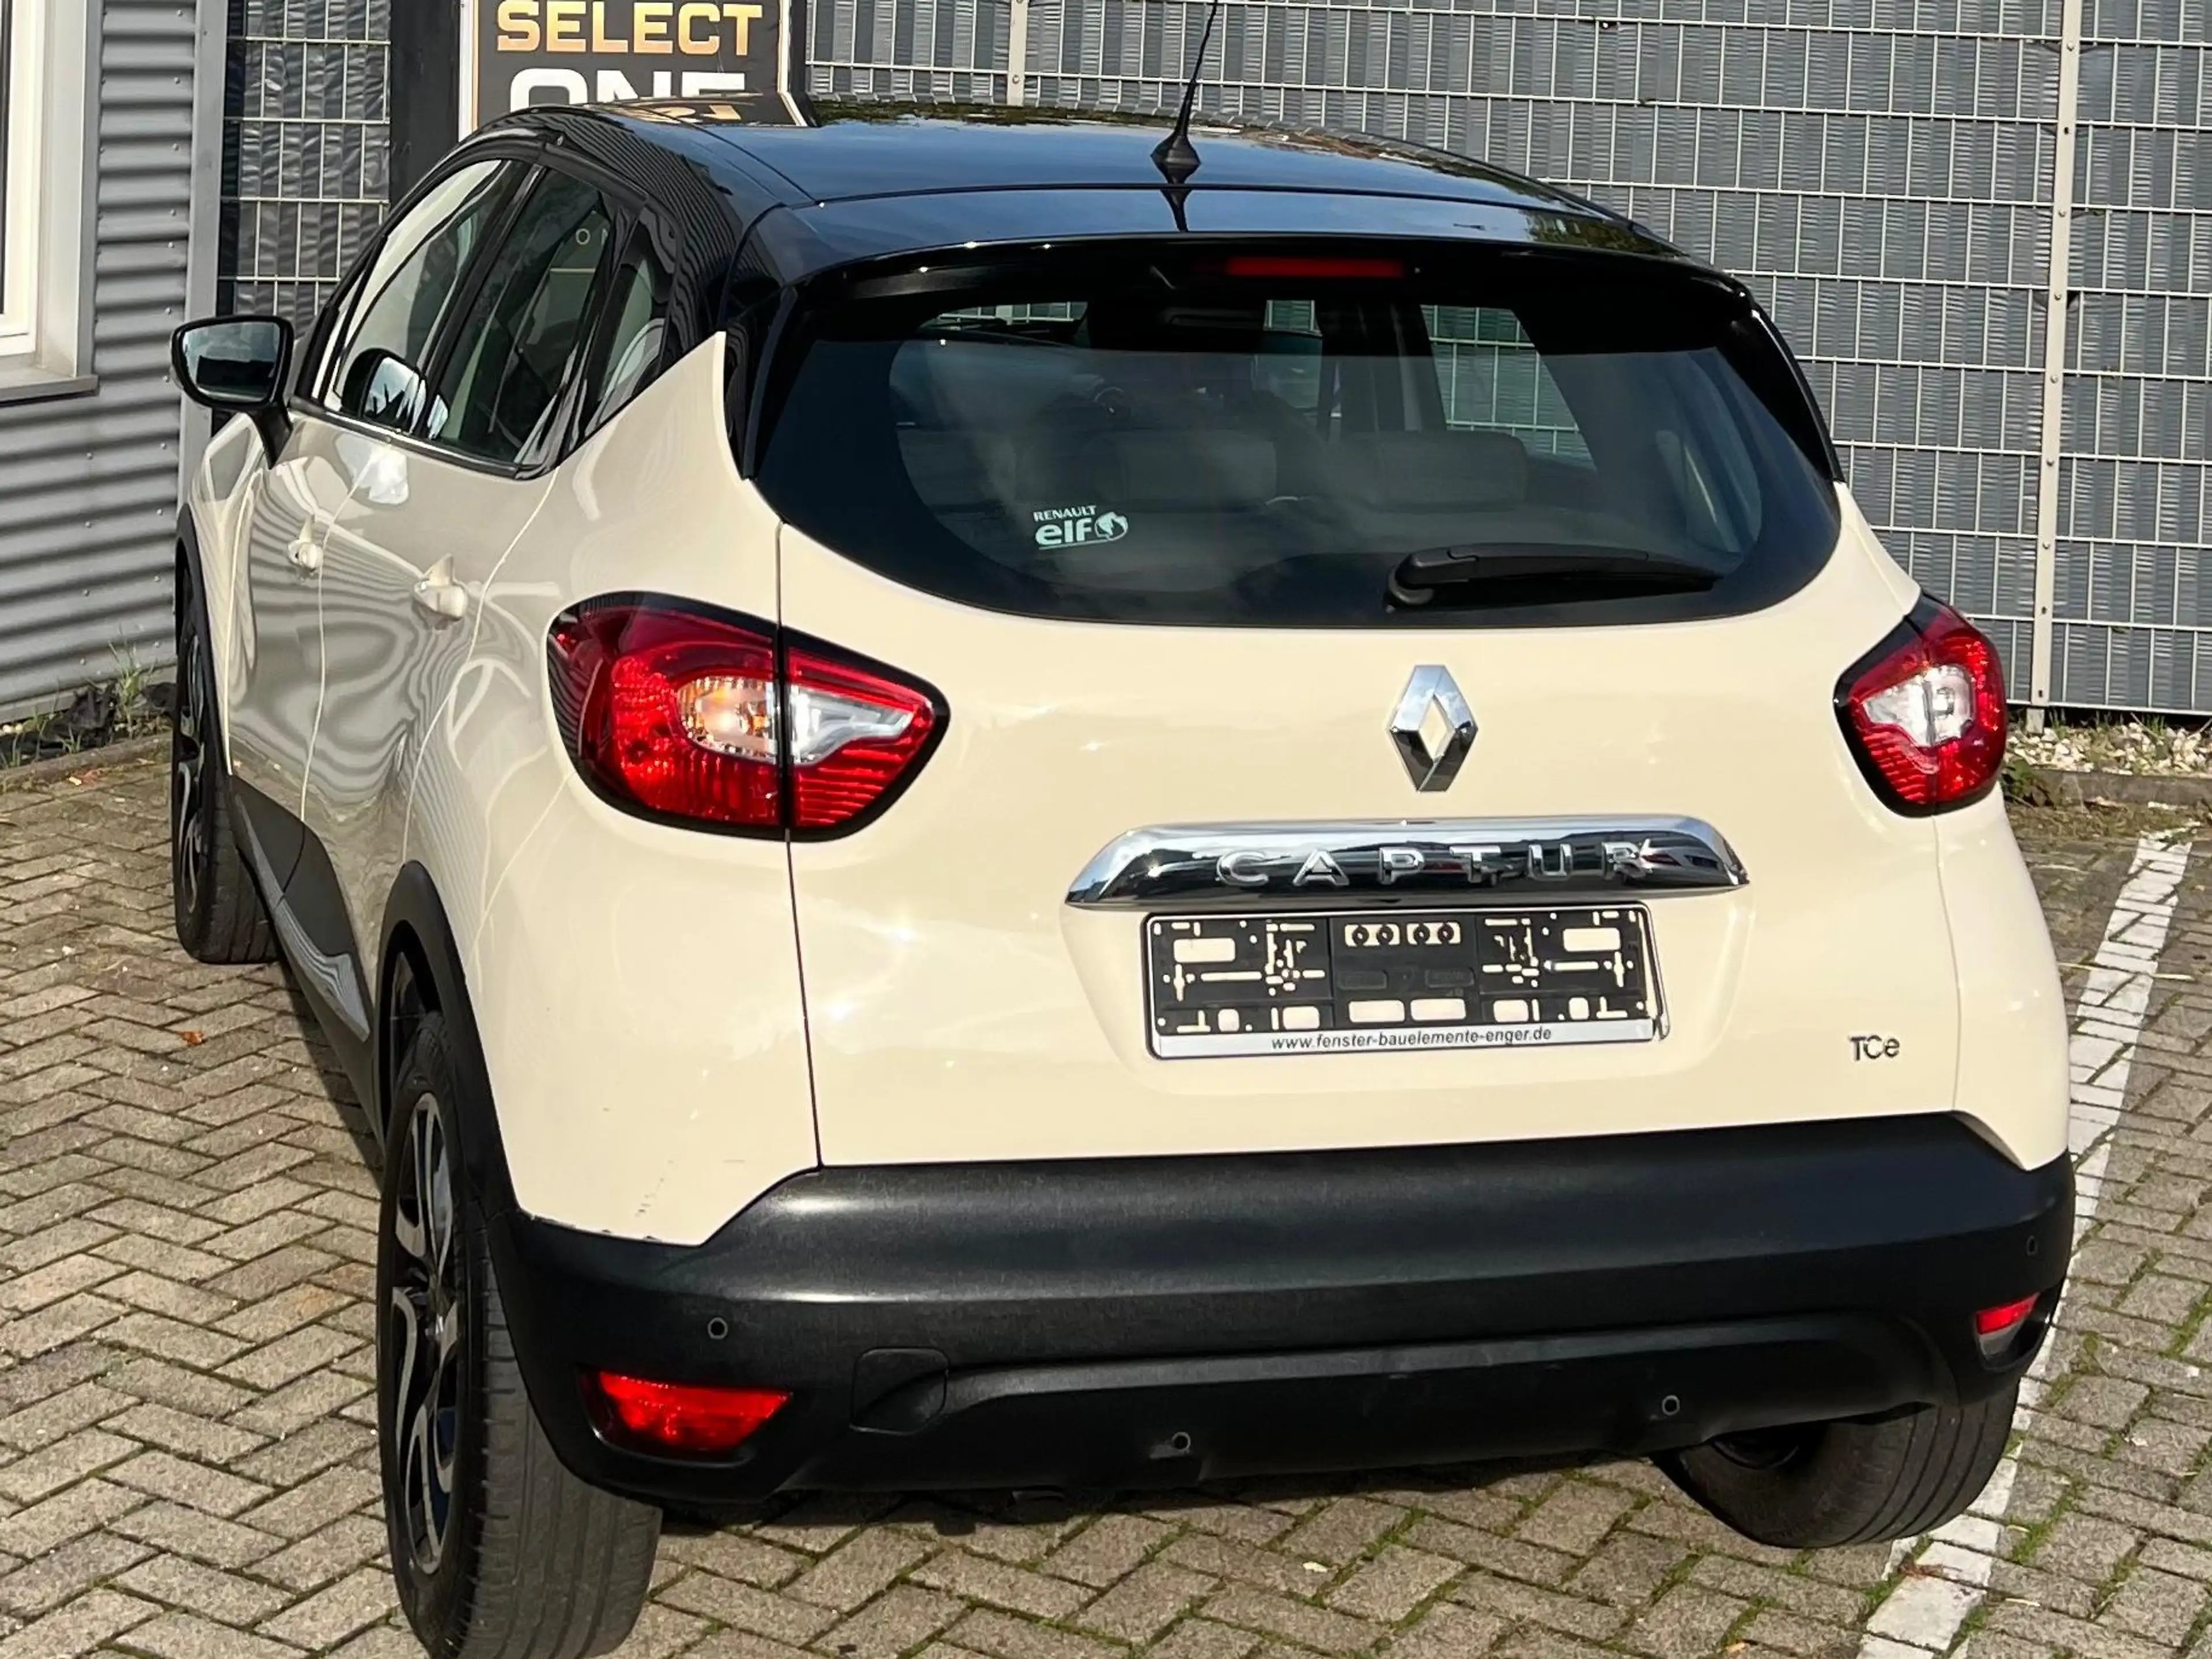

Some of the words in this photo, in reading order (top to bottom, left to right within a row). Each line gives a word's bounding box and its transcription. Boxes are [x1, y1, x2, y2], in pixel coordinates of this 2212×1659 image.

[497, 1, 763, 56] SELECT
[1033, 505, 1096, 522] RENAULT
[1035, 518, 1092, 545] elf
[1215, 841, 1648, 888] CAPTUR
[1271, 1025, 1552, 1050] www.fenster-bauelemente-enger.de
[1849, 1035, 1900, 1061] TCe
